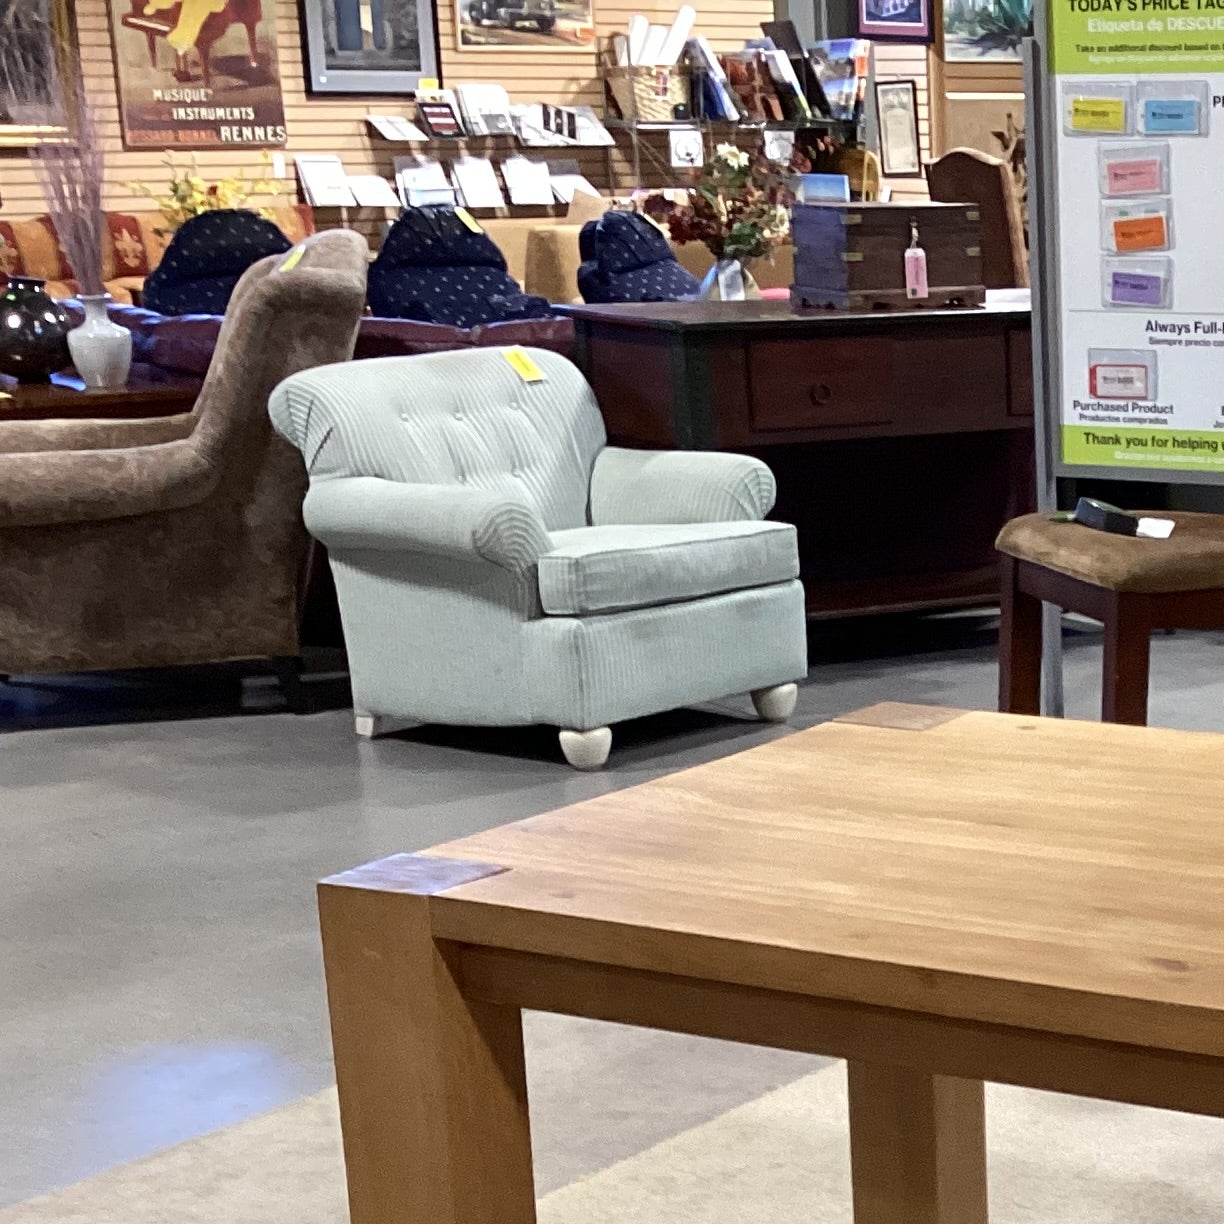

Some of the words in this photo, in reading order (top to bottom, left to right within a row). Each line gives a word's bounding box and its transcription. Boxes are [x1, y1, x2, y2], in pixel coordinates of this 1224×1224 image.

[1069, 0, 1137, 12] TODAY'S
[1142, 0, 1190, 11] PRICE
[1087, 17, 1144, 33] Etiqueta
[1147, 18, 1163, 31] de
[172, 107, 255, 120] INSTRUMENTS
[219, 125, 287, 141] RENNES
[1145, 319, 1191, 335] Always
[1073, 401, 1129, 412] Purchased
[1131, 402, 1174, 414] Product
[1083, 432, 1121, 446] Thank
[1123, 436, 1148, 449] you
[1151, 435, 1169, 448] for
[1171, 436, 1219, 452] helping
